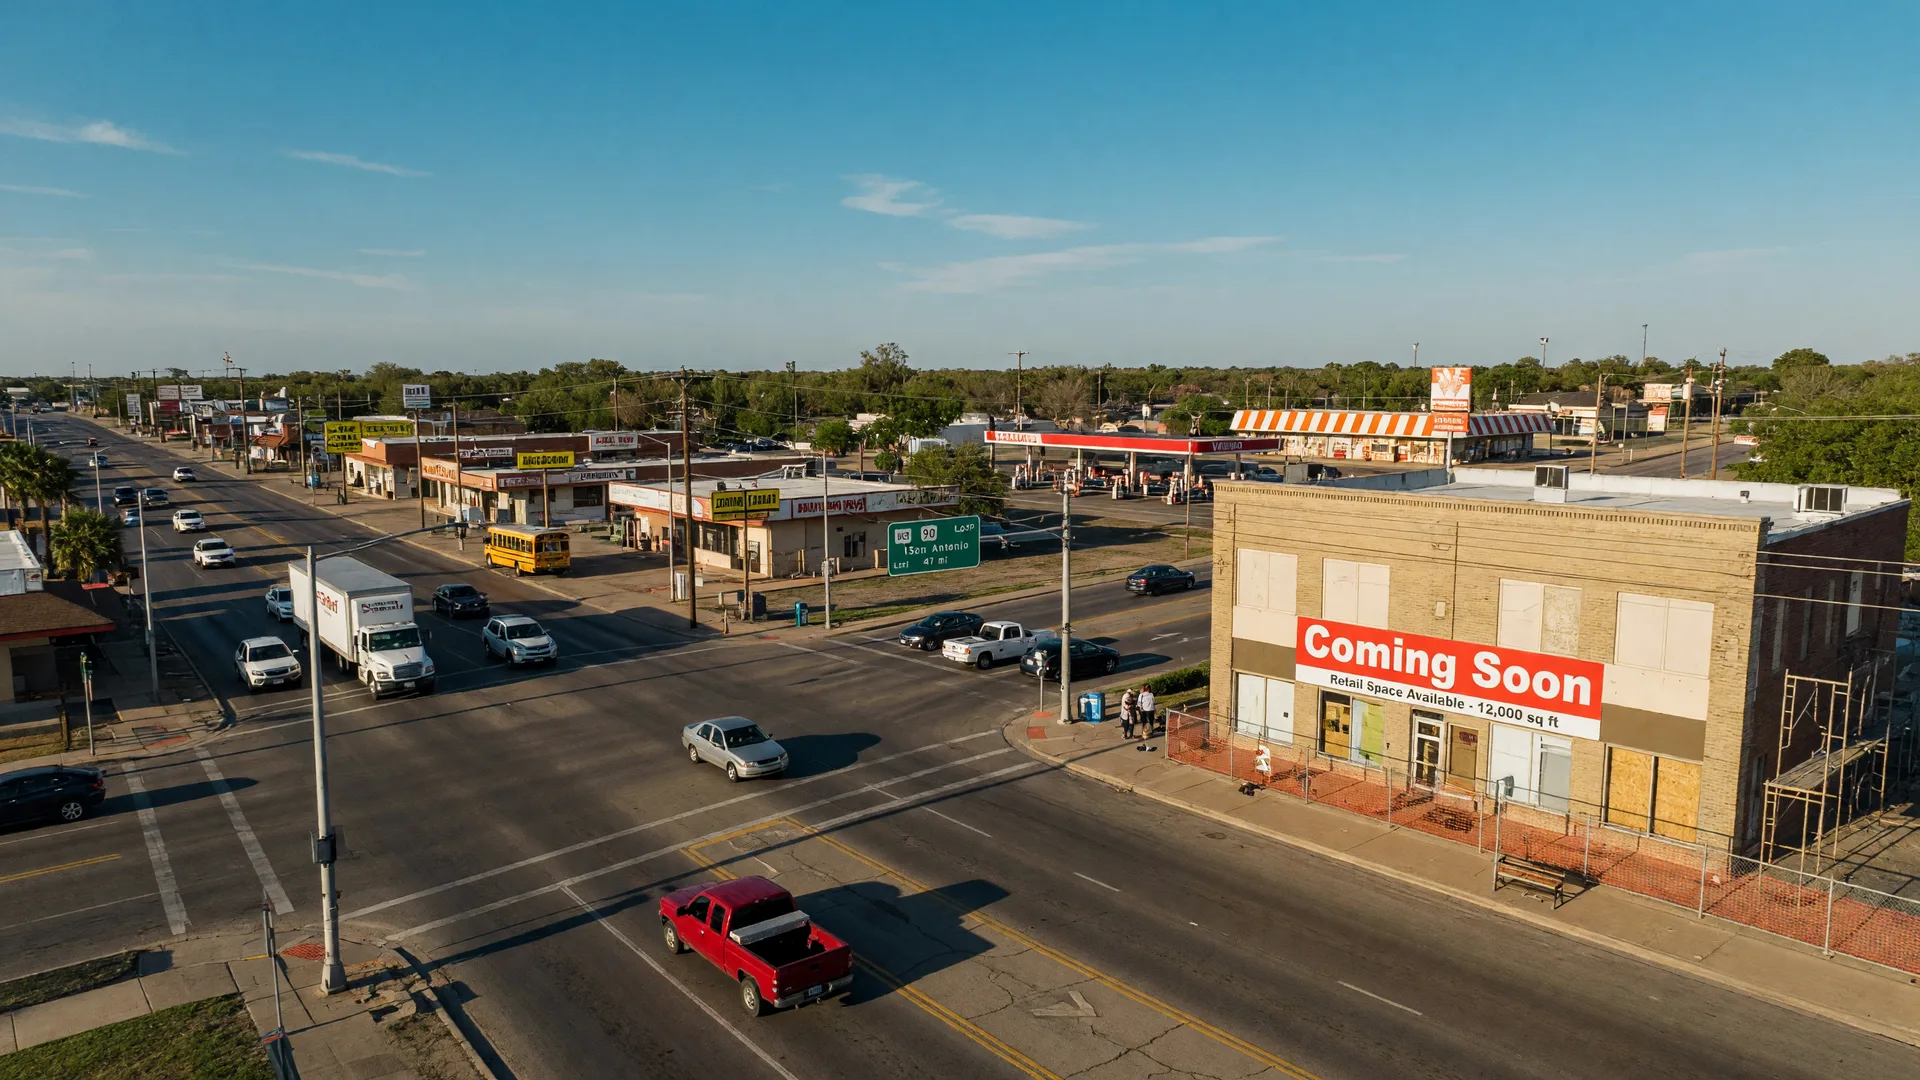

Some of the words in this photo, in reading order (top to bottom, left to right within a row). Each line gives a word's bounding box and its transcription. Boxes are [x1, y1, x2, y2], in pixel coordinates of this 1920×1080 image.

[923, 529, 935, 539] 90
[932, 541, 969, 553] Antonio
[923, 557, 934, 565] 47
[938, 556, 948, 565] mi
[1304, 624, 1456, 690] Coming
[1472, 651, 1591, 706] Soon
[1330, 674, 1363, 690] Retail
[1367, 681, 1403, 697] Space
[1406, 689, 1465, 710] Available
[1477, 702, 1523, 721] 12,000
[1527, 714, 1544, 728] sq
[1548, 716, 1559, 729] ft
